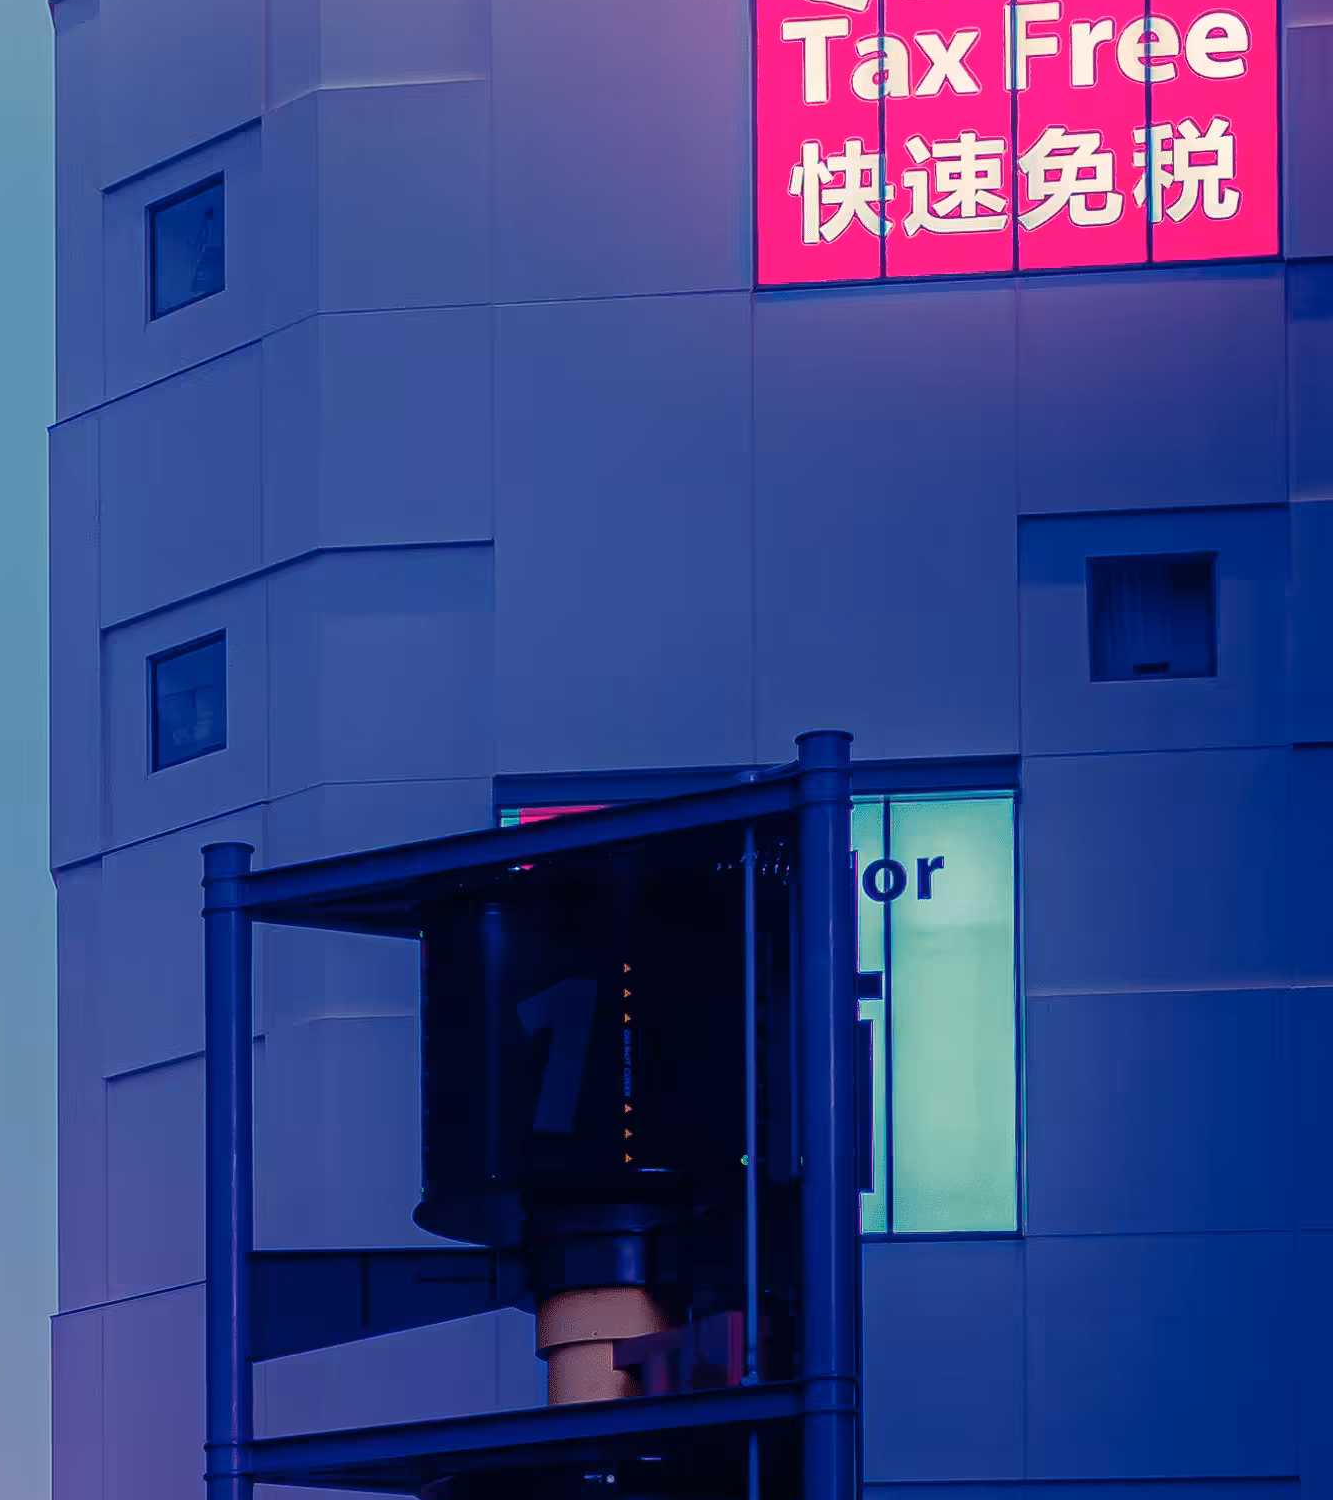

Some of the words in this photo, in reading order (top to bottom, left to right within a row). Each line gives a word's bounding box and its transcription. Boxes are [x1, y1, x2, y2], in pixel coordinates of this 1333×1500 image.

[782, 16, 980, 107] Tax
[792, 118, 1239, 243] 快速免税
